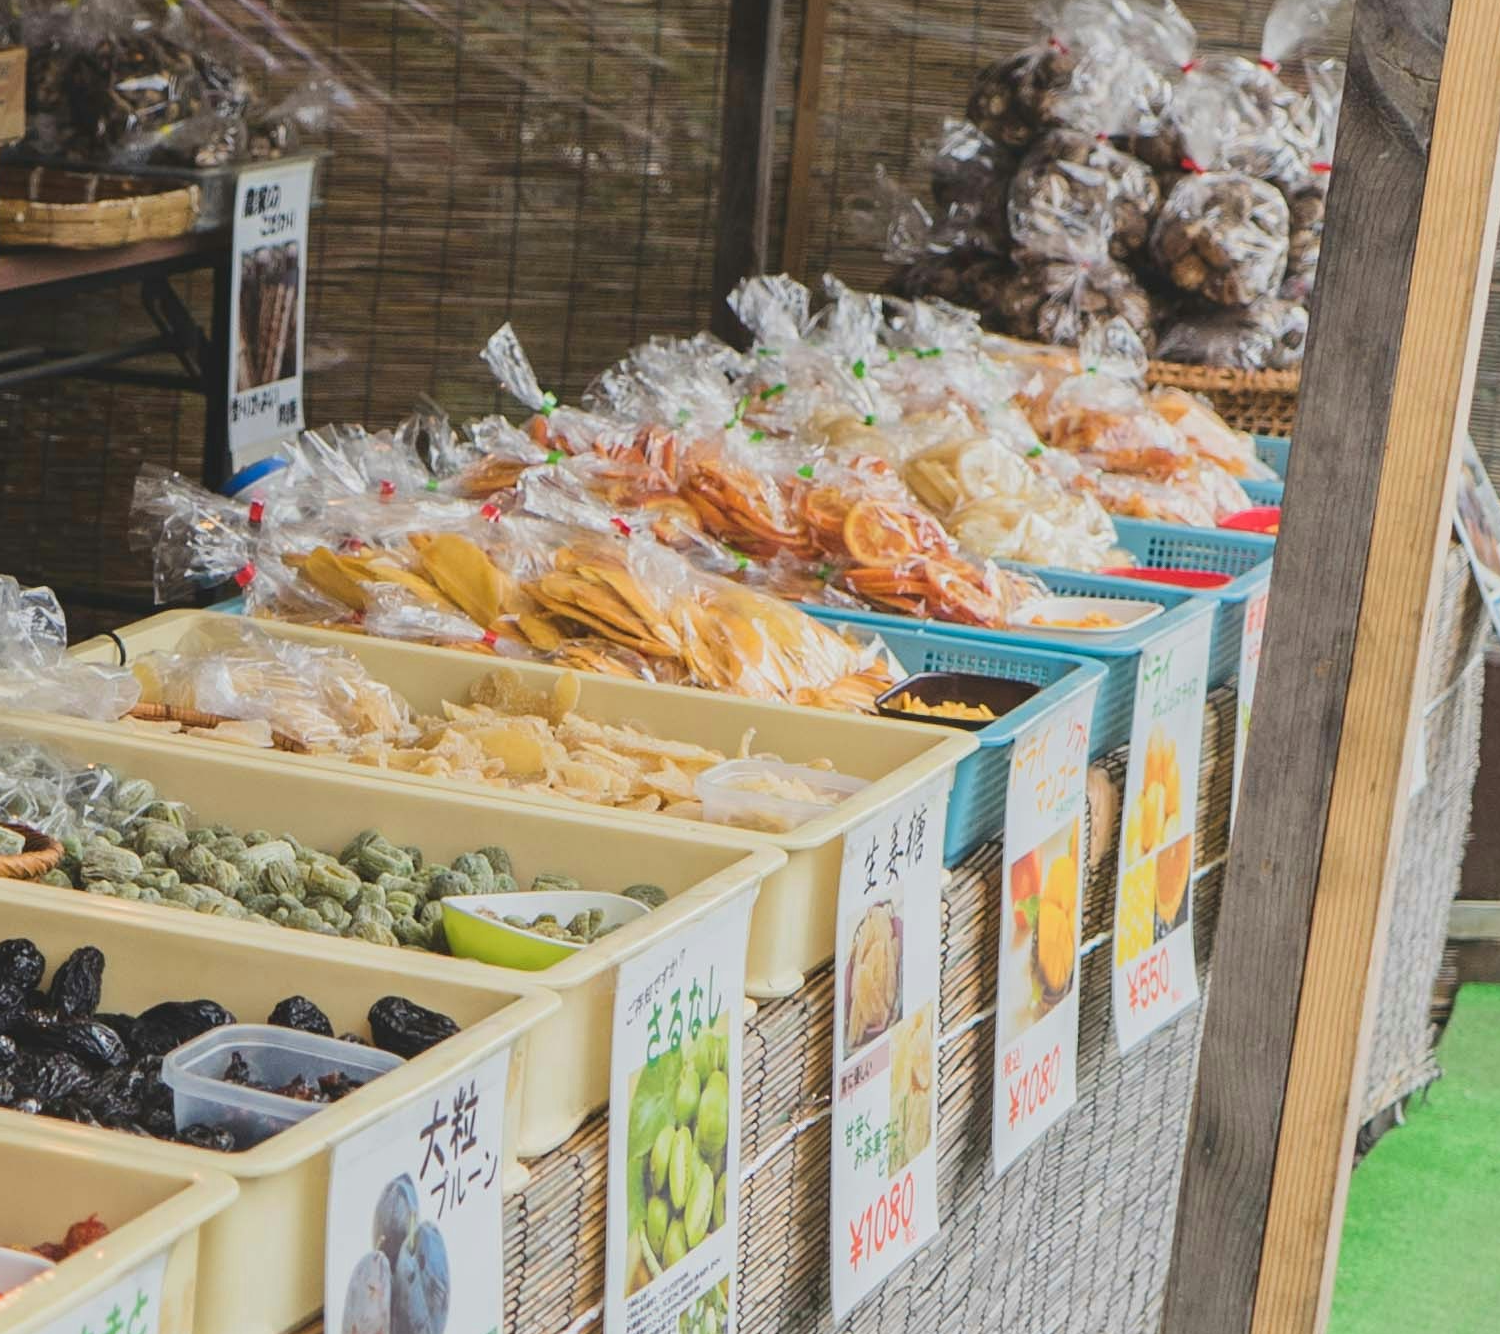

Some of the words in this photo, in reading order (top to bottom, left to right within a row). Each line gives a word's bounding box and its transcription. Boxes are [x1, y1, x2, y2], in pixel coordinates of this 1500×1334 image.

[647, 964, 722, 1068] さるなし
[1127, 946, 1169, 1018] ¥550
[419, 1079, 479, 1182] 大粒
[1009, 1045, 1061, 1131] ¥1080
[431, 1151, 498, 1220] プルーン
[849, 1171, 914, 1273] ¥1080
